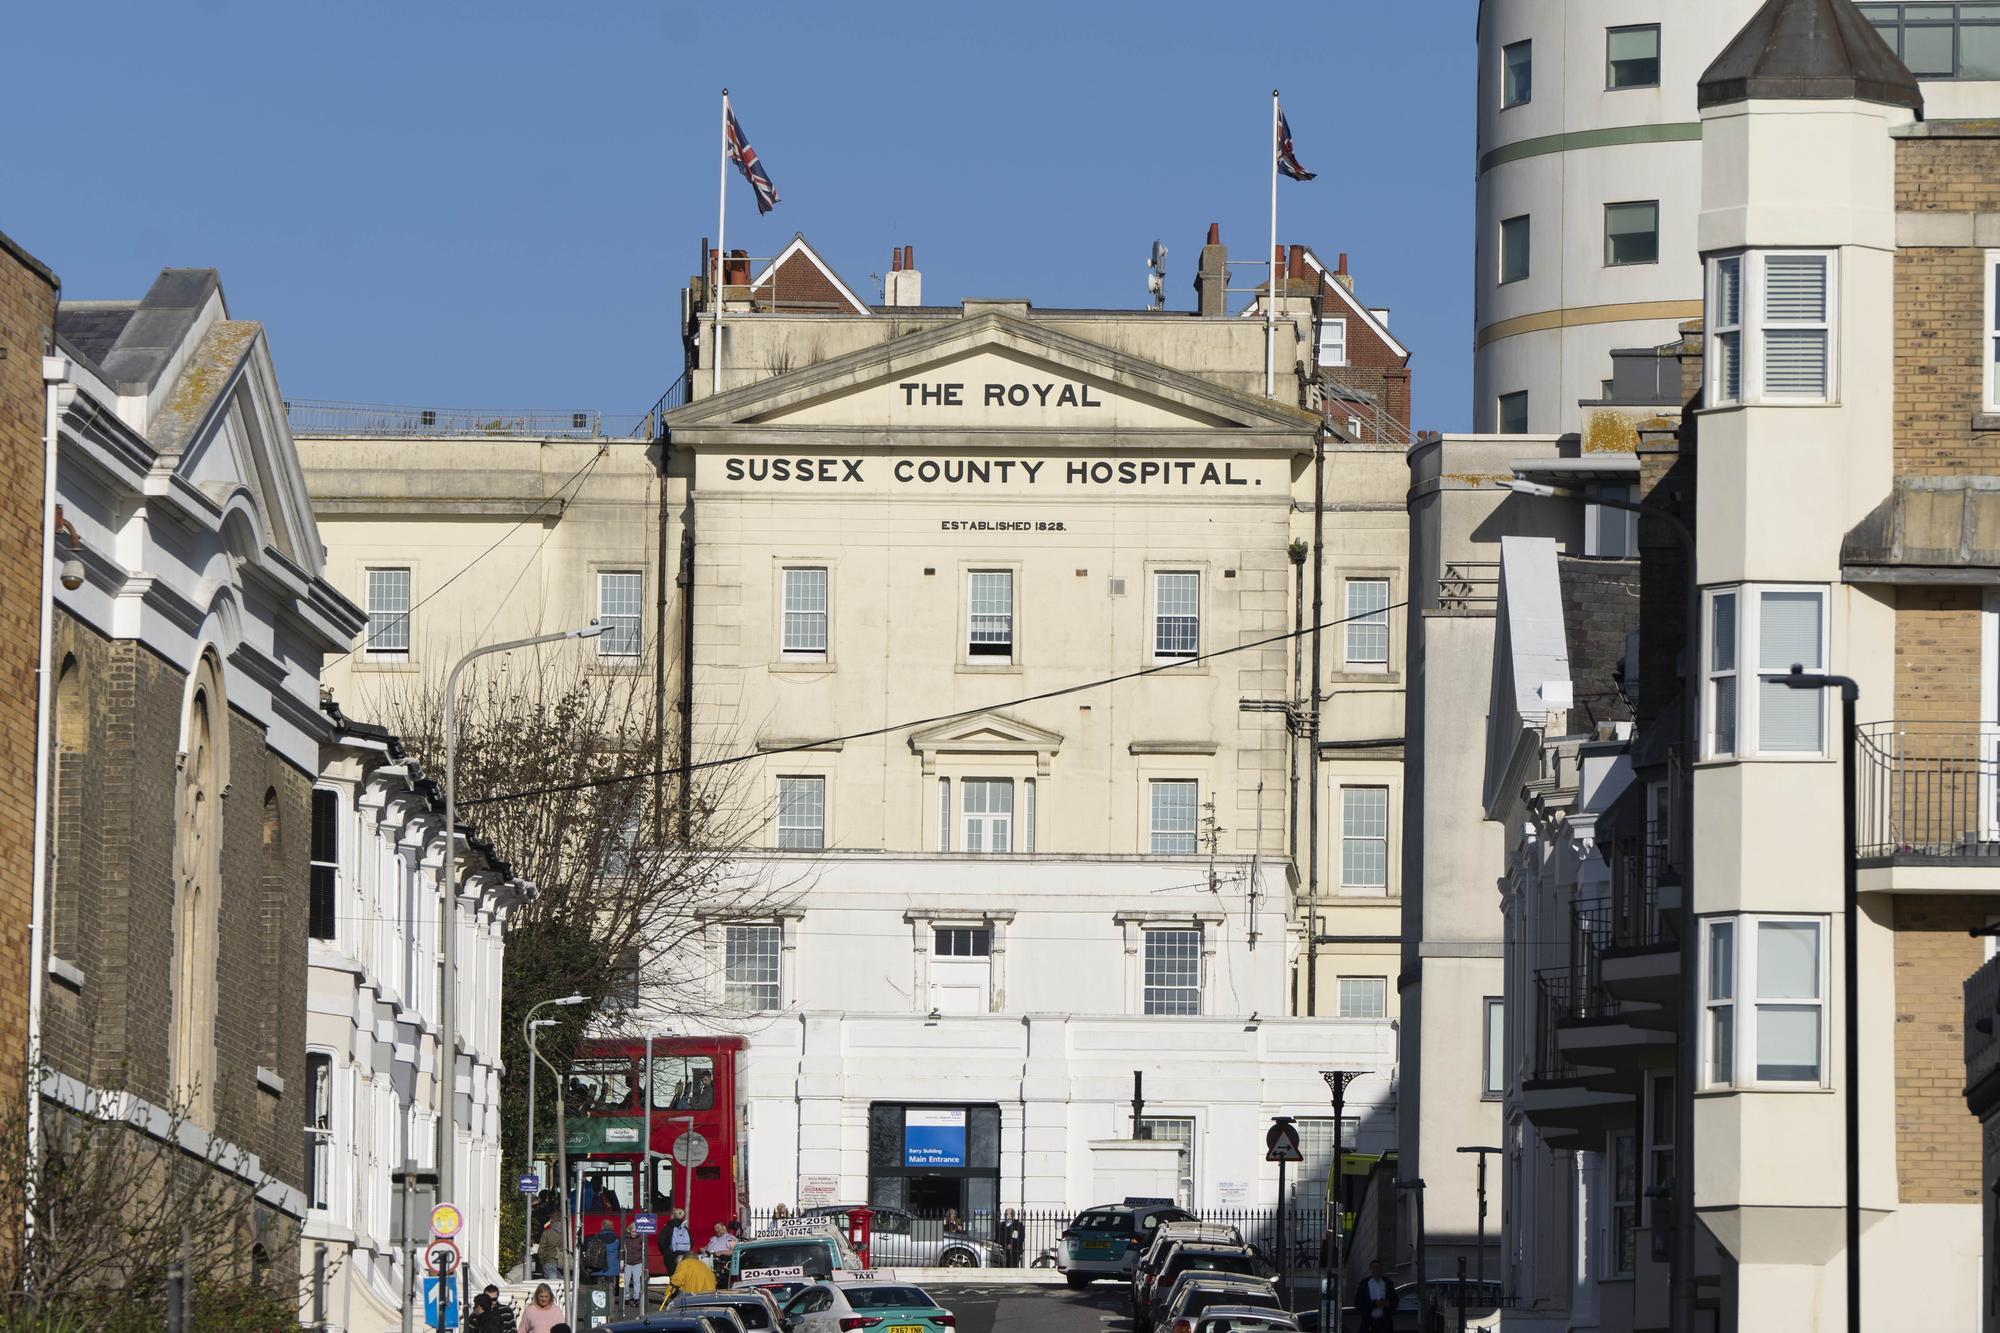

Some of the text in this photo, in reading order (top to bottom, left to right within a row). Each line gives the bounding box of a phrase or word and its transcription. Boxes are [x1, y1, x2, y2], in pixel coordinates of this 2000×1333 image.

[900, 383, 1101, 407] THE ROYAL
[726, 458, 1262, 485] SUSSEX COUNTY HOSPITAL.
[941, 521, 1067, 531] ESTABLISHED 1828.
[757, 1227, 811, 1238] 202020 747474
[432, 1250, 455, 1264] 20
